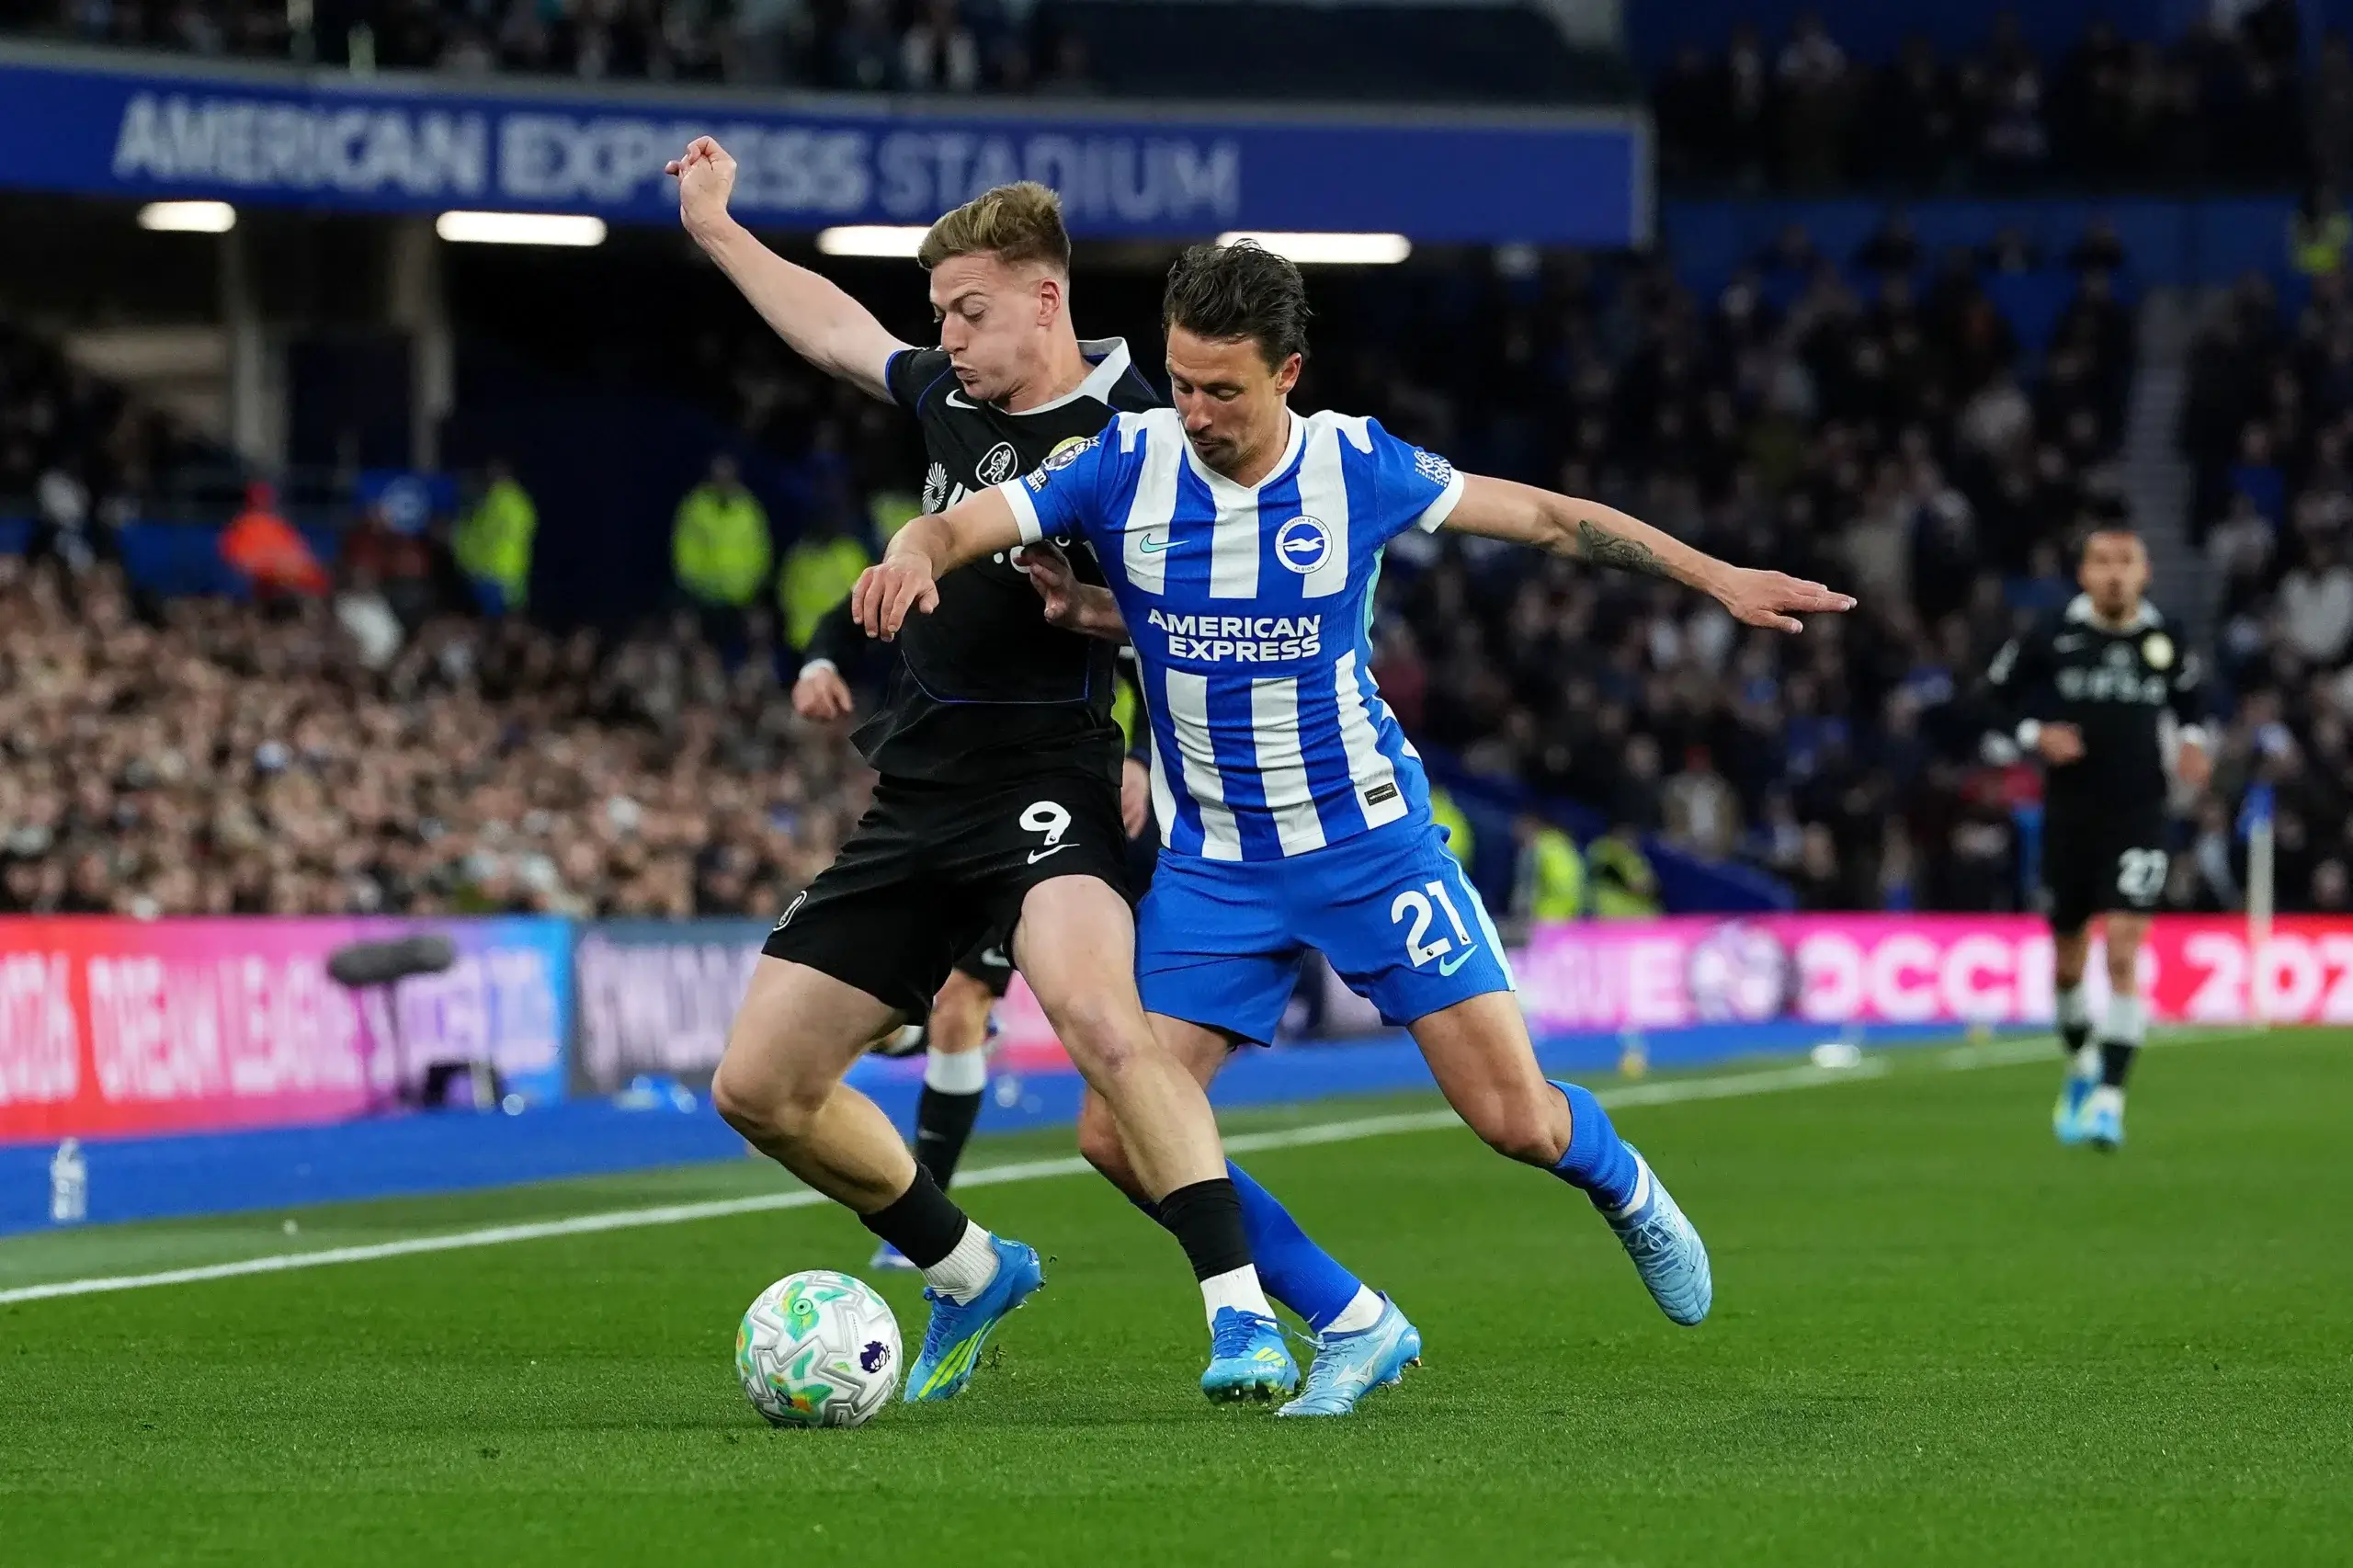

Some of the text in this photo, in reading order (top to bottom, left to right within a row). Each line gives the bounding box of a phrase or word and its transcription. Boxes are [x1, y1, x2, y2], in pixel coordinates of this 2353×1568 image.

[113, 90, 485, 195] AMERICAN
[1280, 517, 1306, 535] BRIGHTON
[1148, 608, 1321, 639] AMERICAN
[1168, 633, 1321, 663] EXPRESS
[1018, 801, 1072, 846] 9
[1391, 880, 1472, 968] 21
